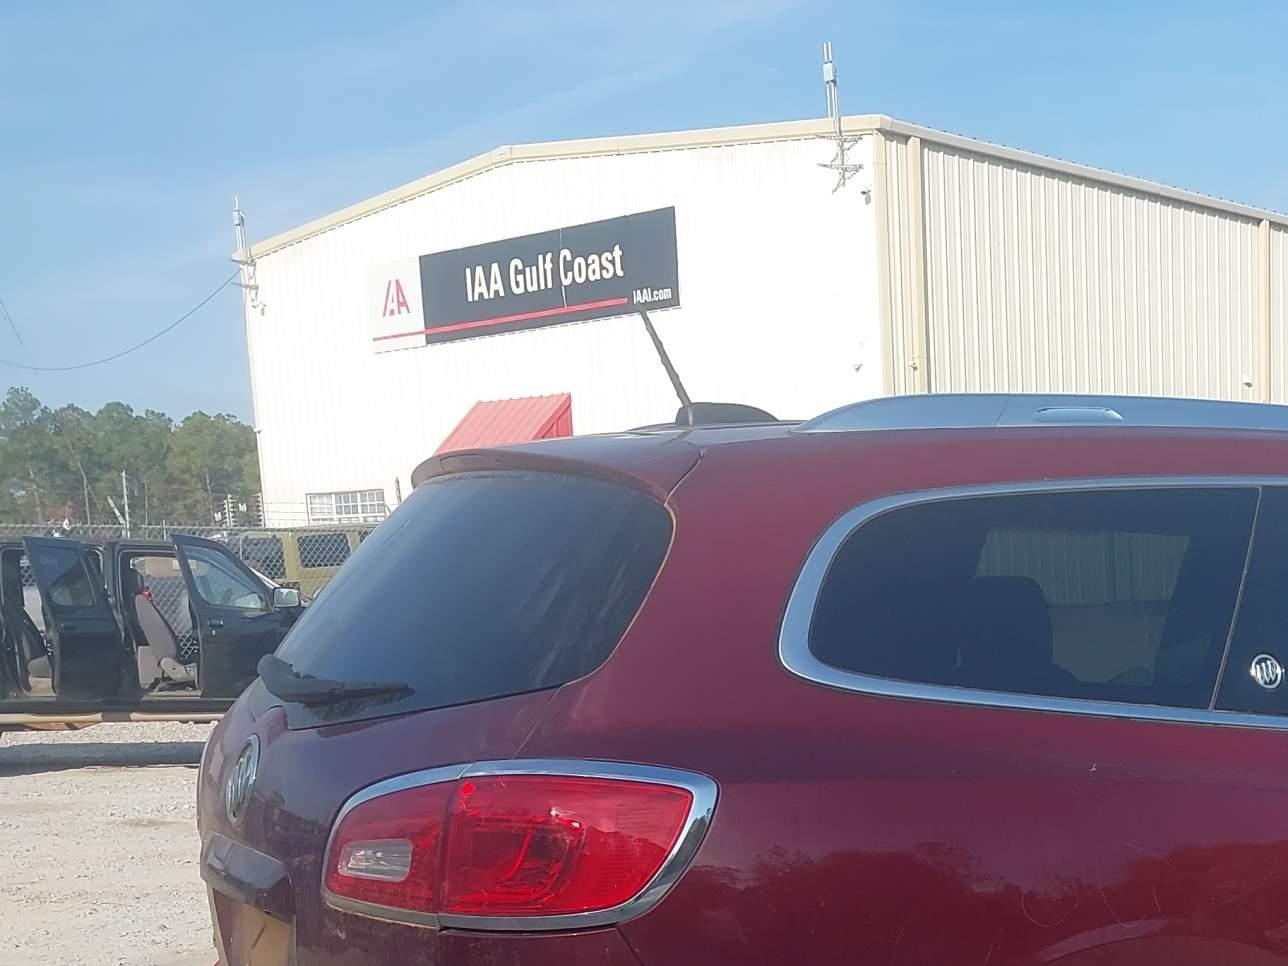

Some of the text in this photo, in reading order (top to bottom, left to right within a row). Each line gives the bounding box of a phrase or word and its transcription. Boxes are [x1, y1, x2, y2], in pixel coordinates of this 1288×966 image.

[466, 243, 624, 302] IAA Gulf Coast
[632, 286, 672, 305] IAAI.com
